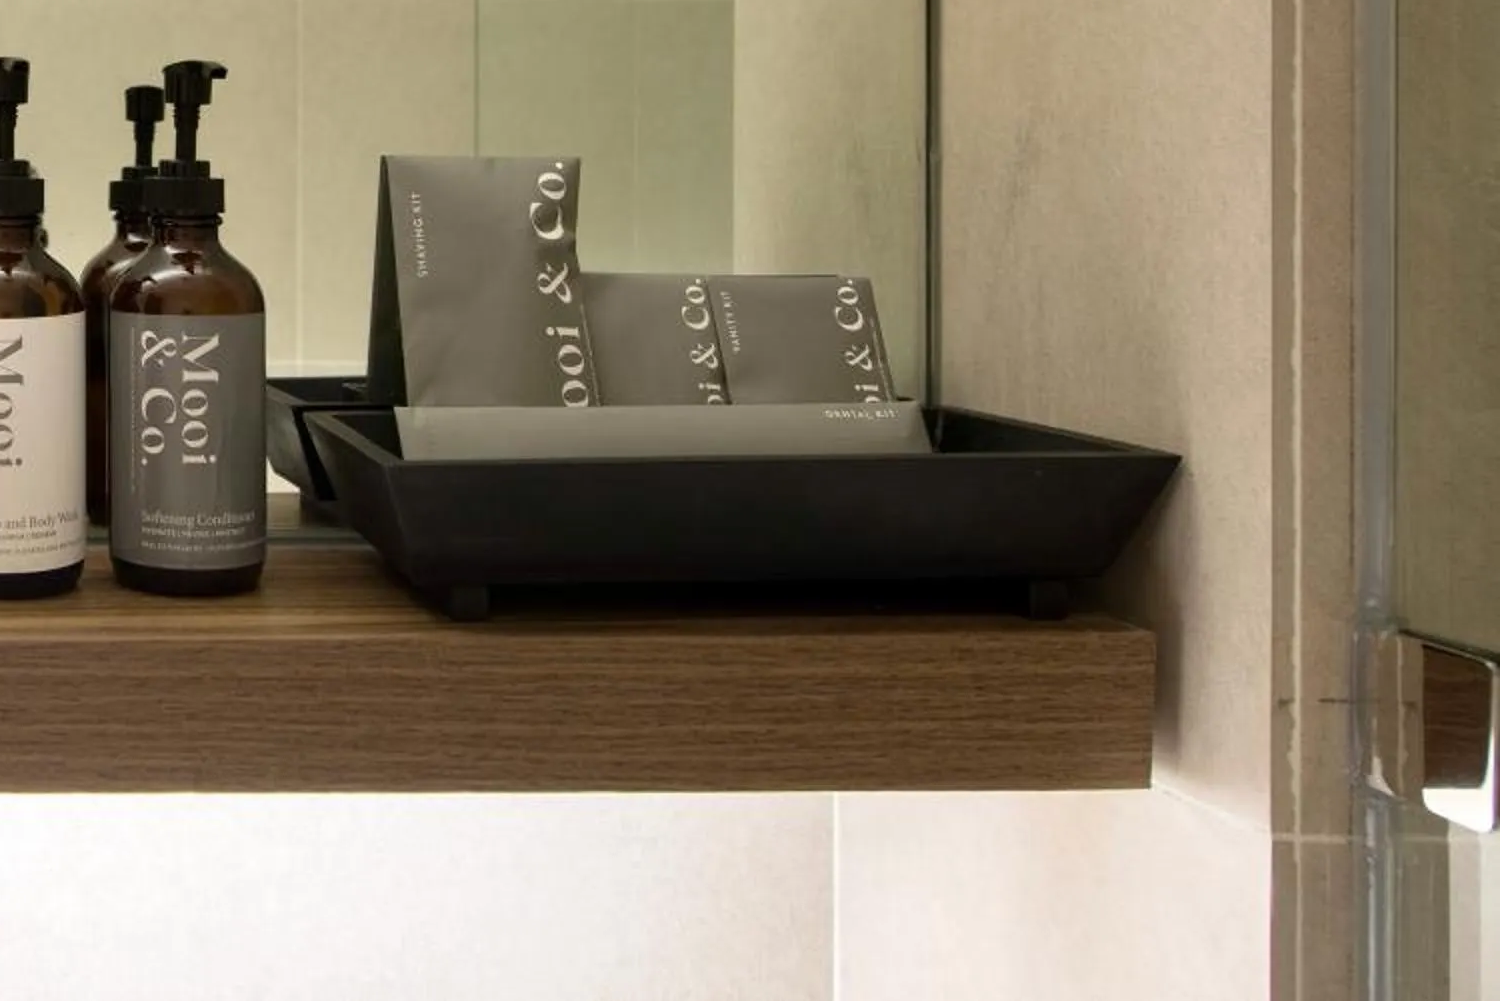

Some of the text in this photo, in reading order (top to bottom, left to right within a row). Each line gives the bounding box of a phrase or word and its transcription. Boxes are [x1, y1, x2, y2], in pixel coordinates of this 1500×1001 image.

[410, 191, 428, 279] SHAVING KIT
[529, 161, 589, 407] ooi & Co.
[681, 278, 710, 330] Co.
[834, 278, 864, 331] Co.
[689, 342, 719, 369] &
[844, 344, 873, 371] &
[140, 330, 178, 466] & Co.
[181, 331, 220, 465] Mooi
